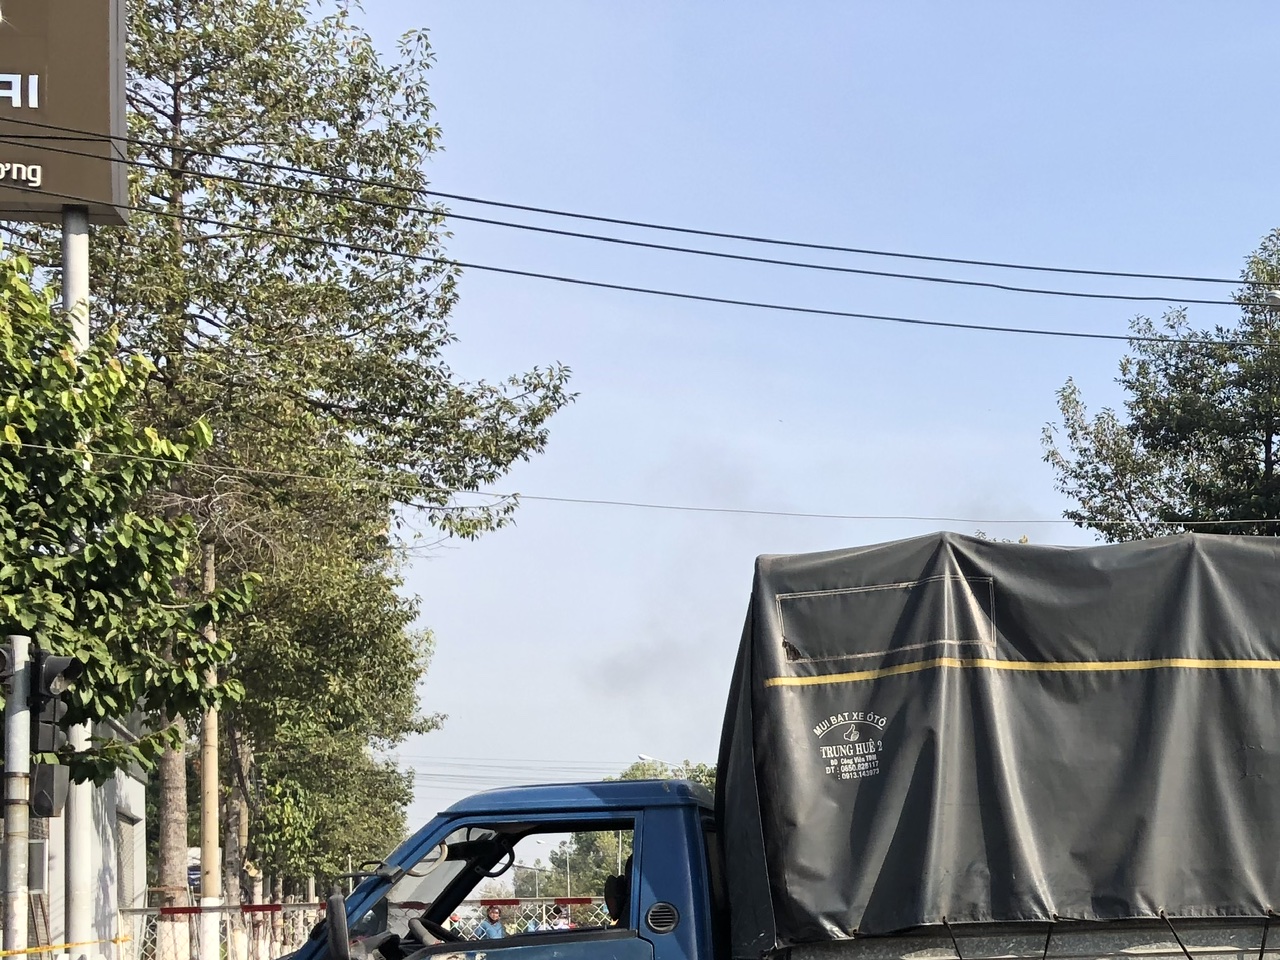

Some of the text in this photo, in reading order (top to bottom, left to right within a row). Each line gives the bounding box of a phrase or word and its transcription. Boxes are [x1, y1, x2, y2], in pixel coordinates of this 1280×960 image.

[813, 719, 830, 736] MUI
[852, 711, 864, 720] XE
[820, 744, 853, 759] TRUNG
[877, 740, 883, 752] 2
